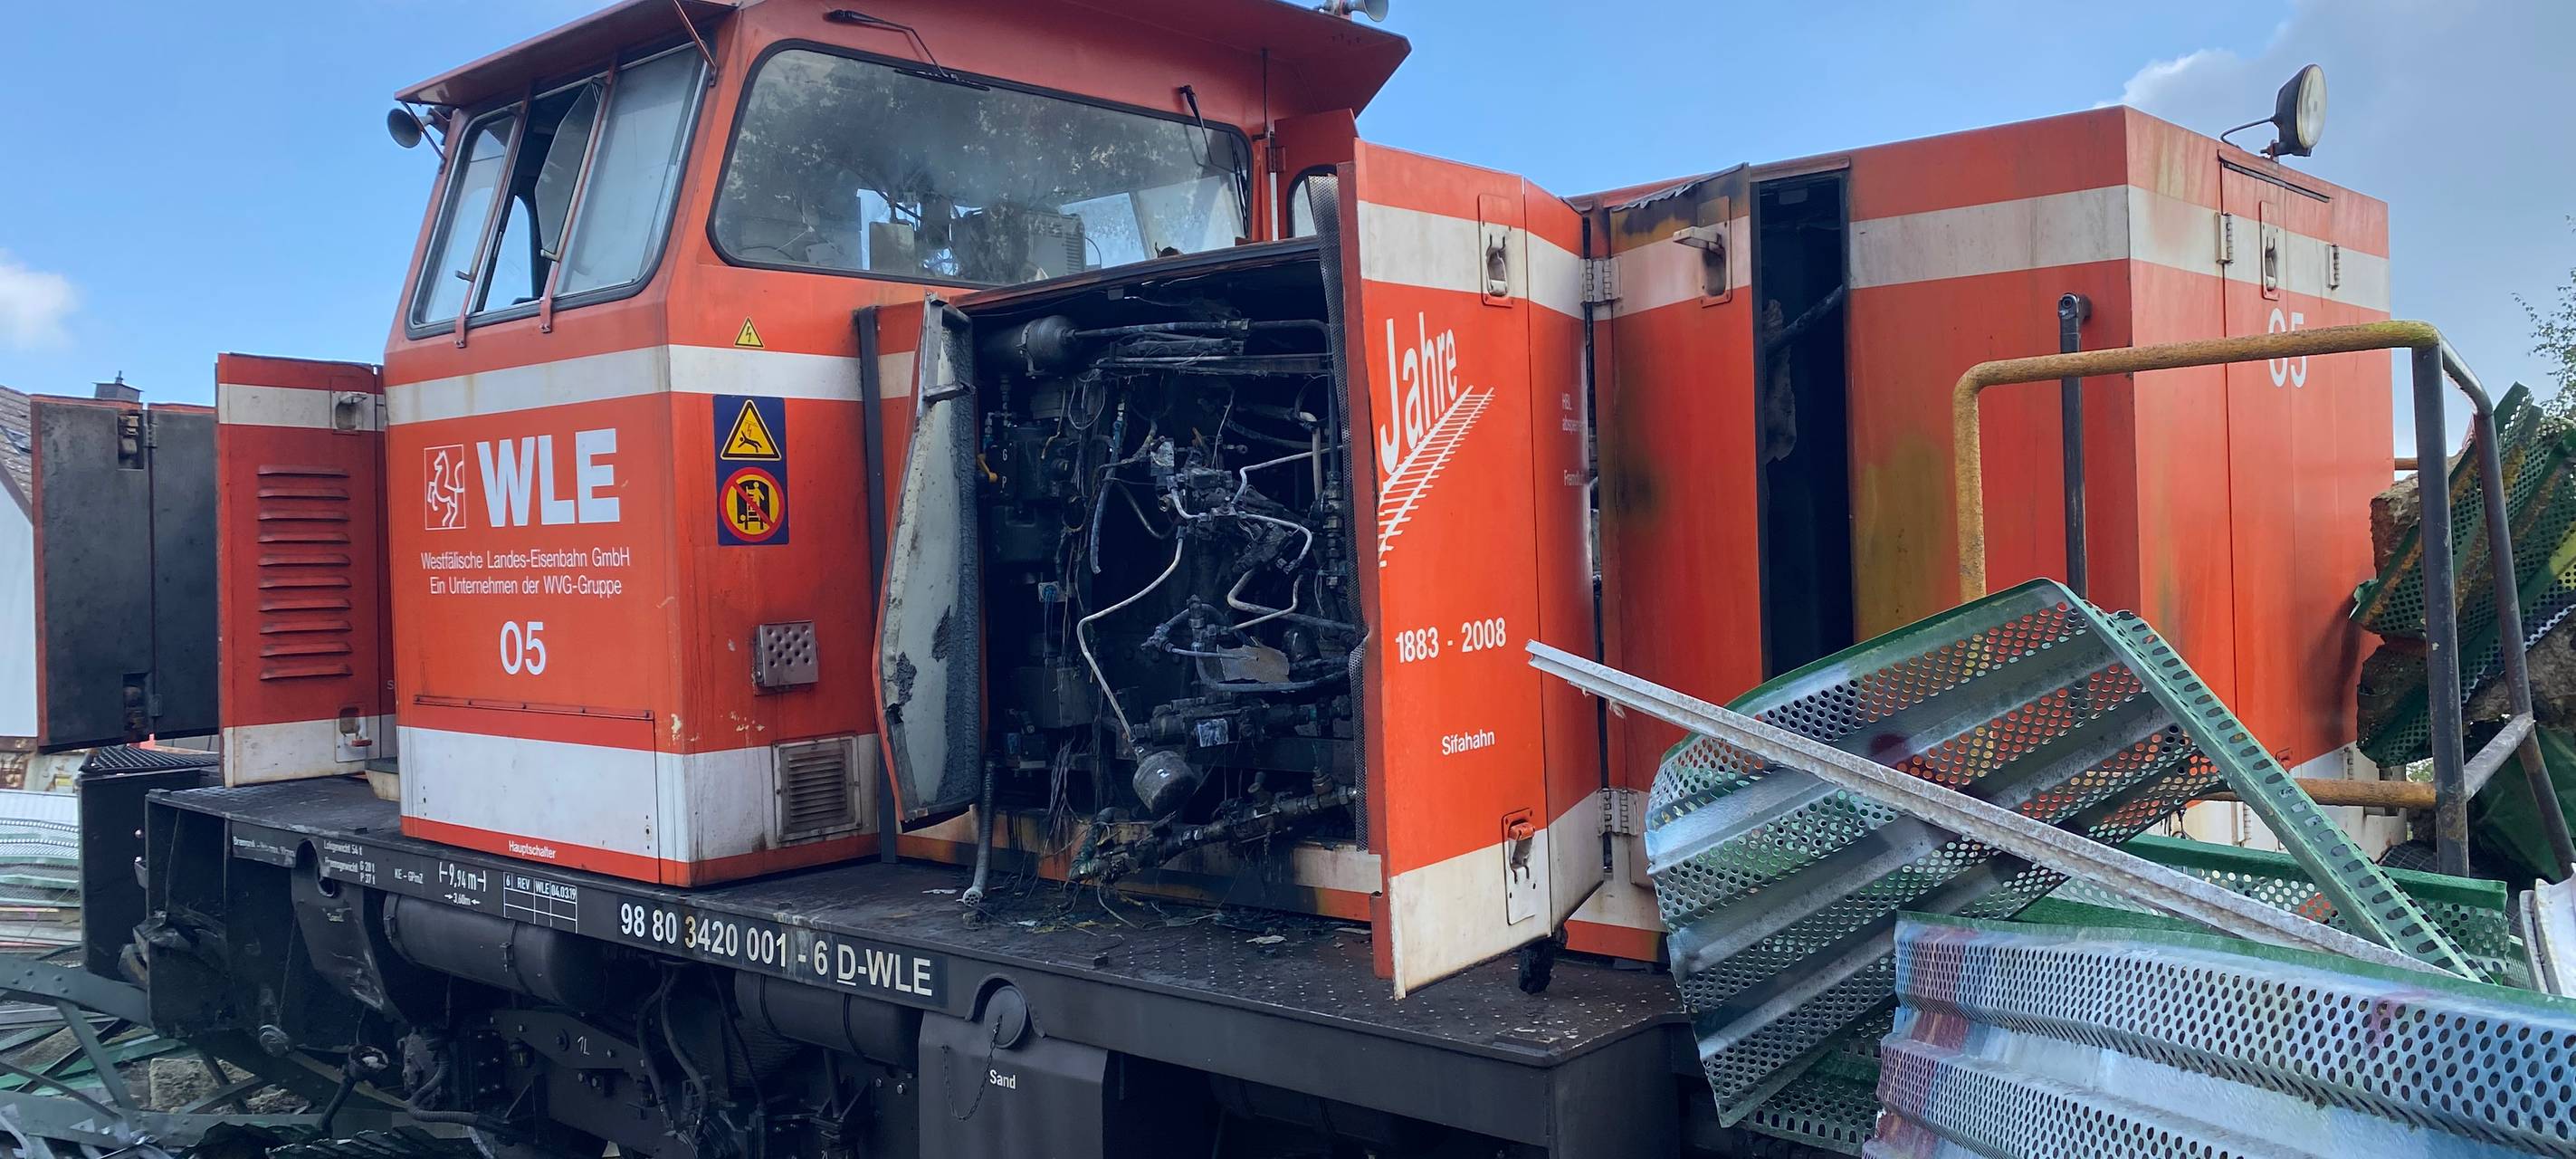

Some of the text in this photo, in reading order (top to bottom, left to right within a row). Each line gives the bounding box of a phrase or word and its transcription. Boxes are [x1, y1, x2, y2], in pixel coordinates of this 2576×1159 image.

[2268, 308, 2307, 388] 05
[1380, 311, 1459, 475] Jahre
[1002, 448, 1007, 462] G
[476, 427, 620, 527] WLE
[421, 546, 631, 570] Westfälische Landes-Eisenbahn GmbH
[430, 573, 623, 599] Ein Unternehmen der WVG-Gruppe
[500, 620, 547, 675] 05
[1395, 626, 1439, 664] 1883
[1461, 616, 1506, 653] 2008
[1441, 728, 1495, 756] Sifahahn
[508, 839, 557, 860] Hauptschalter
[449, 863, 466, 889] 9,94
[505, 876, 510, 887] 6
[517, 877, 530, 890] REV
[535, 881, 549, 895] WLE
[620, 903, 645, 938] 98
[652, 909, 677, 944] 80
[684, 915, 739, 958] 3420
[746, 926, 787, 967] 001
[814, 940, 828, 976] 6
[836, 943, 932, 996] D-WLE
[989, 1068, 1016, 1090] Sand
